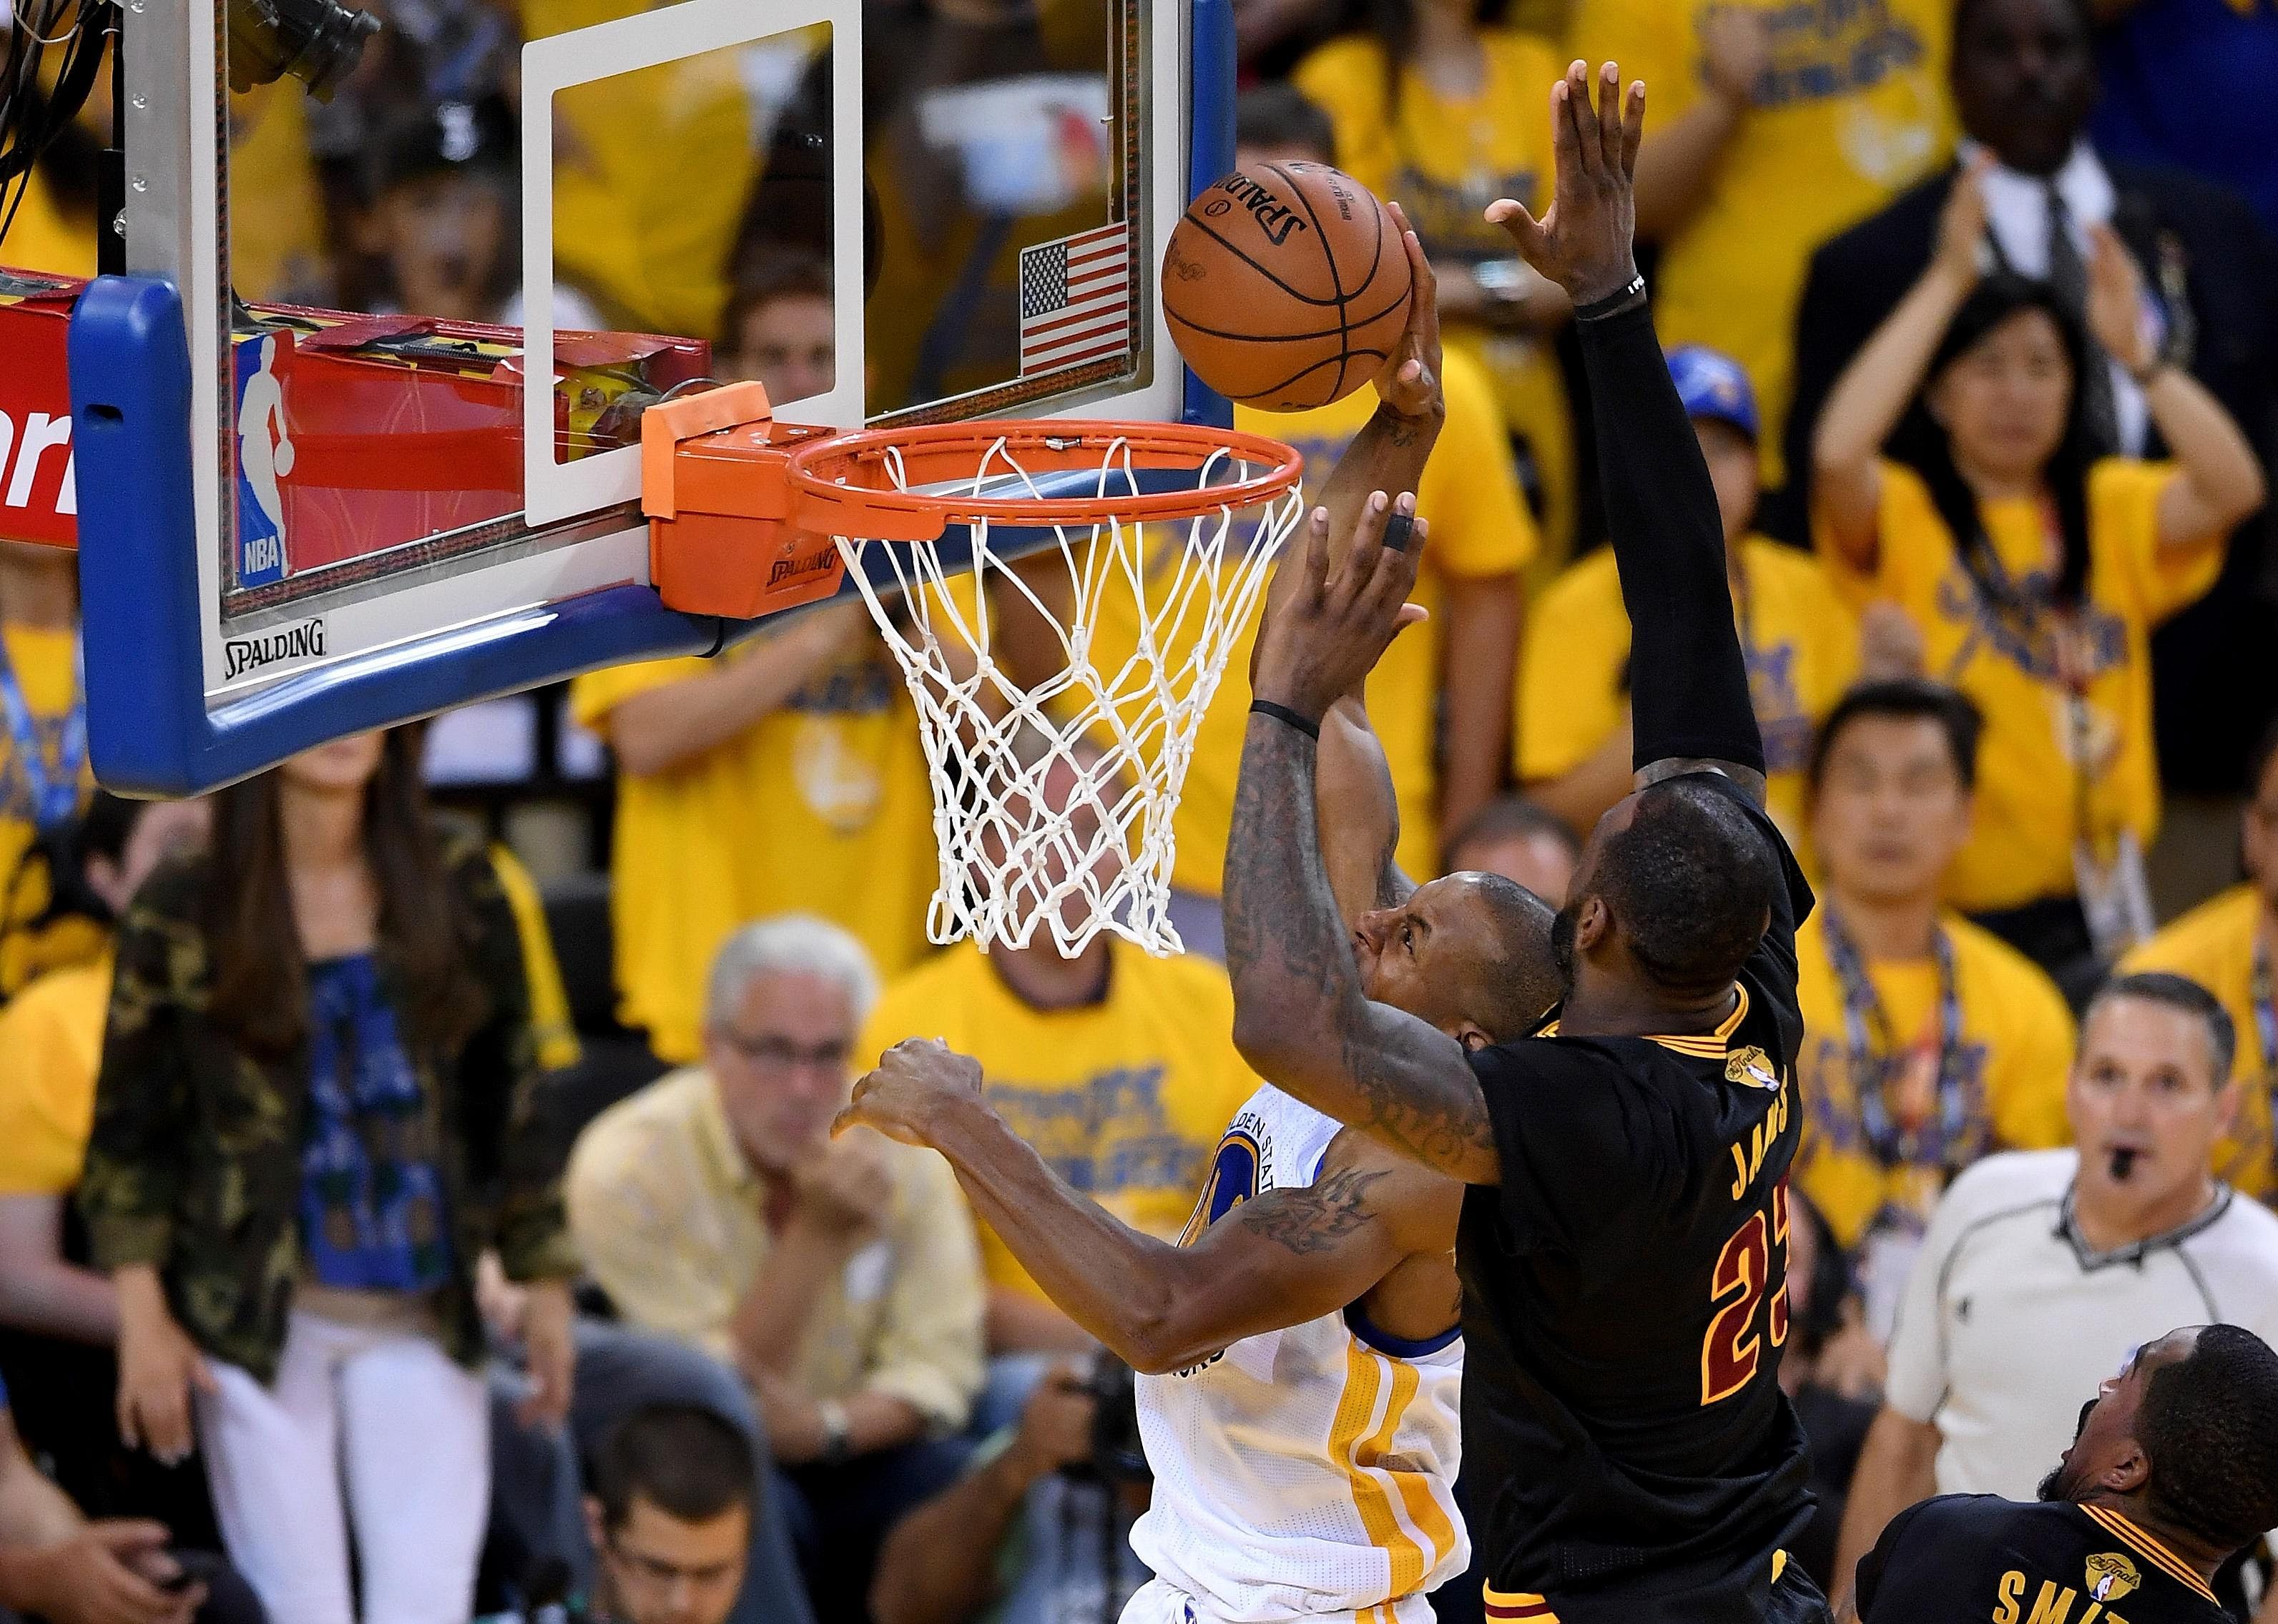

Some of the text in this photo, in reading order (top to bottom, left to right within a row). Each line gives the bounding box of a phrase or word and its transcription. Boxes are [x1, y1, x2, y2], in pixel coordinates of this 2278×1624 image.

[1213, 172, 1308, 246] SPALD
[244, 536, 280, 576] NBA
[225, 619, 325, 681] SPALDING
[1222, 1112, 1266, 1139] LDEN
